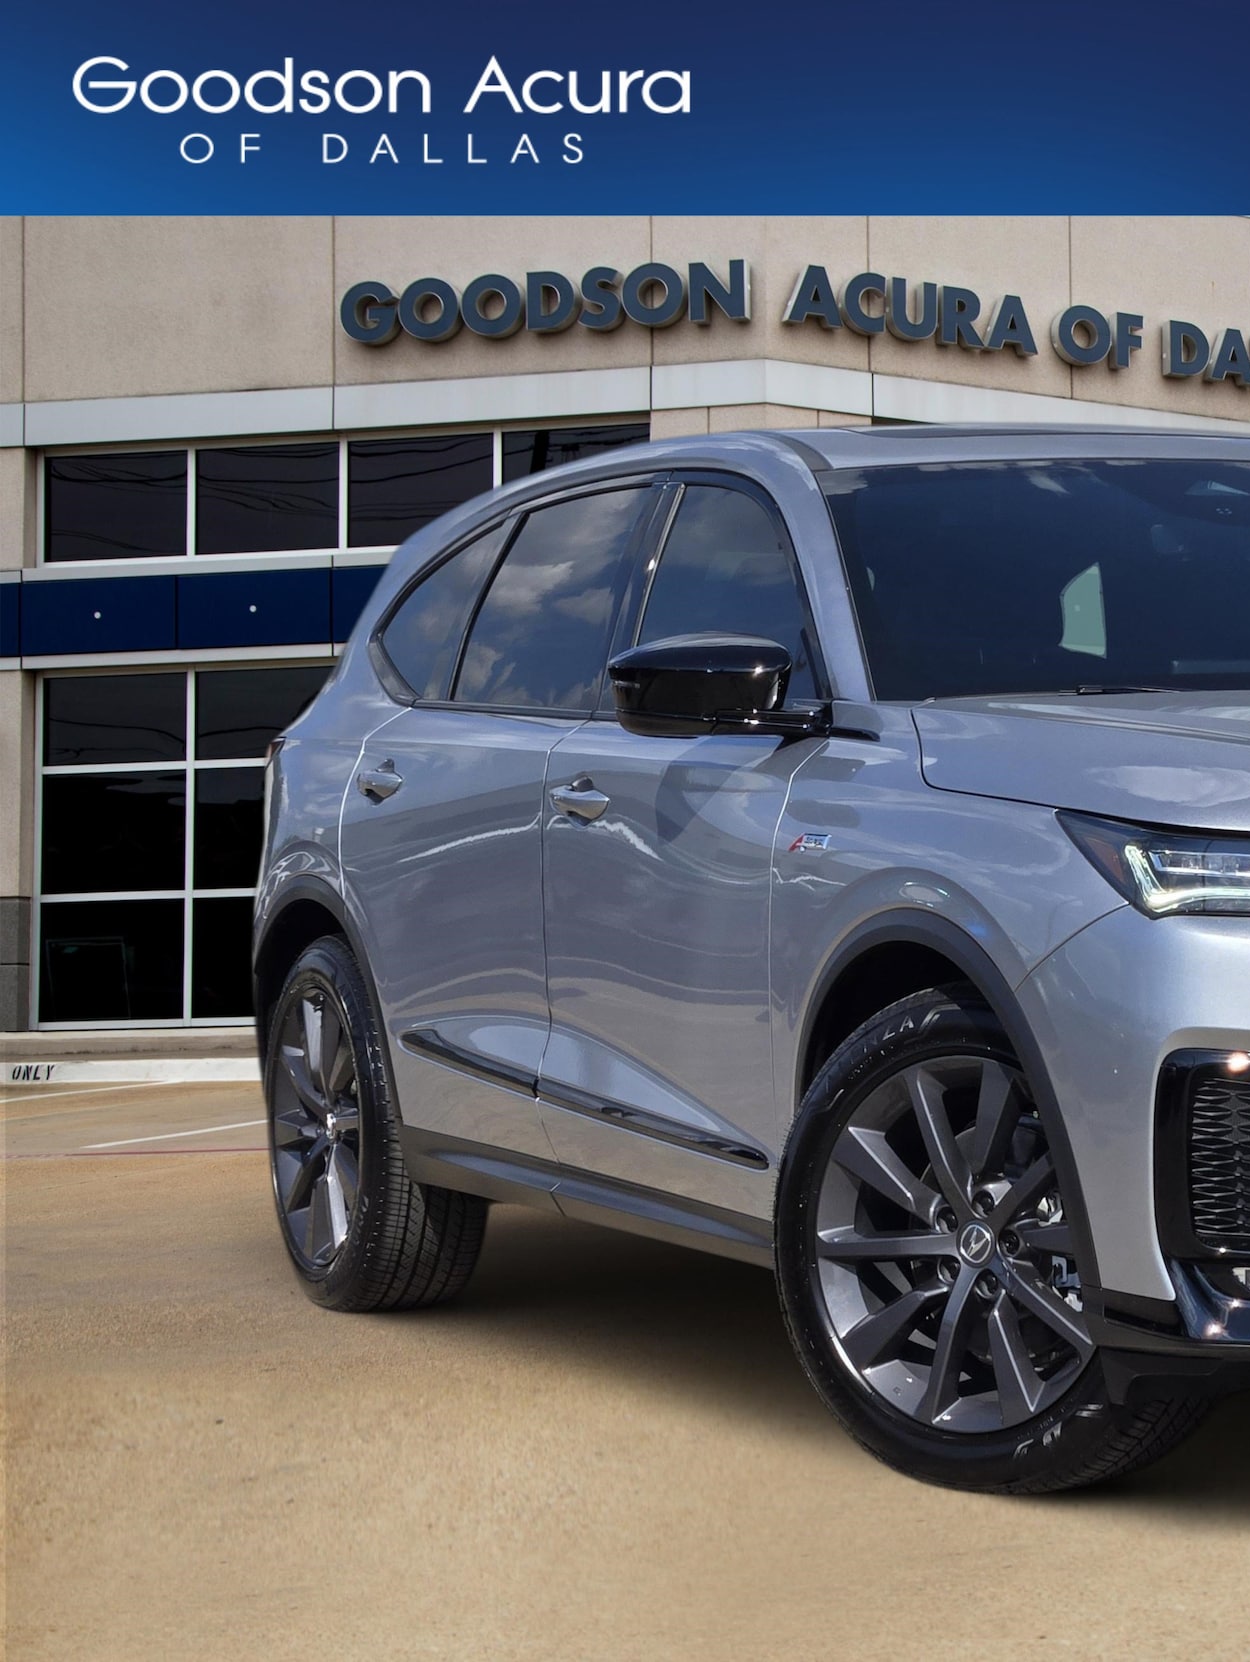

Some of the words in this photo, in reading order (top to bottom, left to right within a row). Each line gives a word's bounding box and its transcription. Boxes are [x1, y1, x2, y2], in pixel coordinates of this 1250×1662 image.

[340, 259, 749, 345] GOODSON
[782, 264, 1038, 356] ACURA
[1052, 305, 1144, 369] OF
[11, 1064, 55, 1081] ONLY
